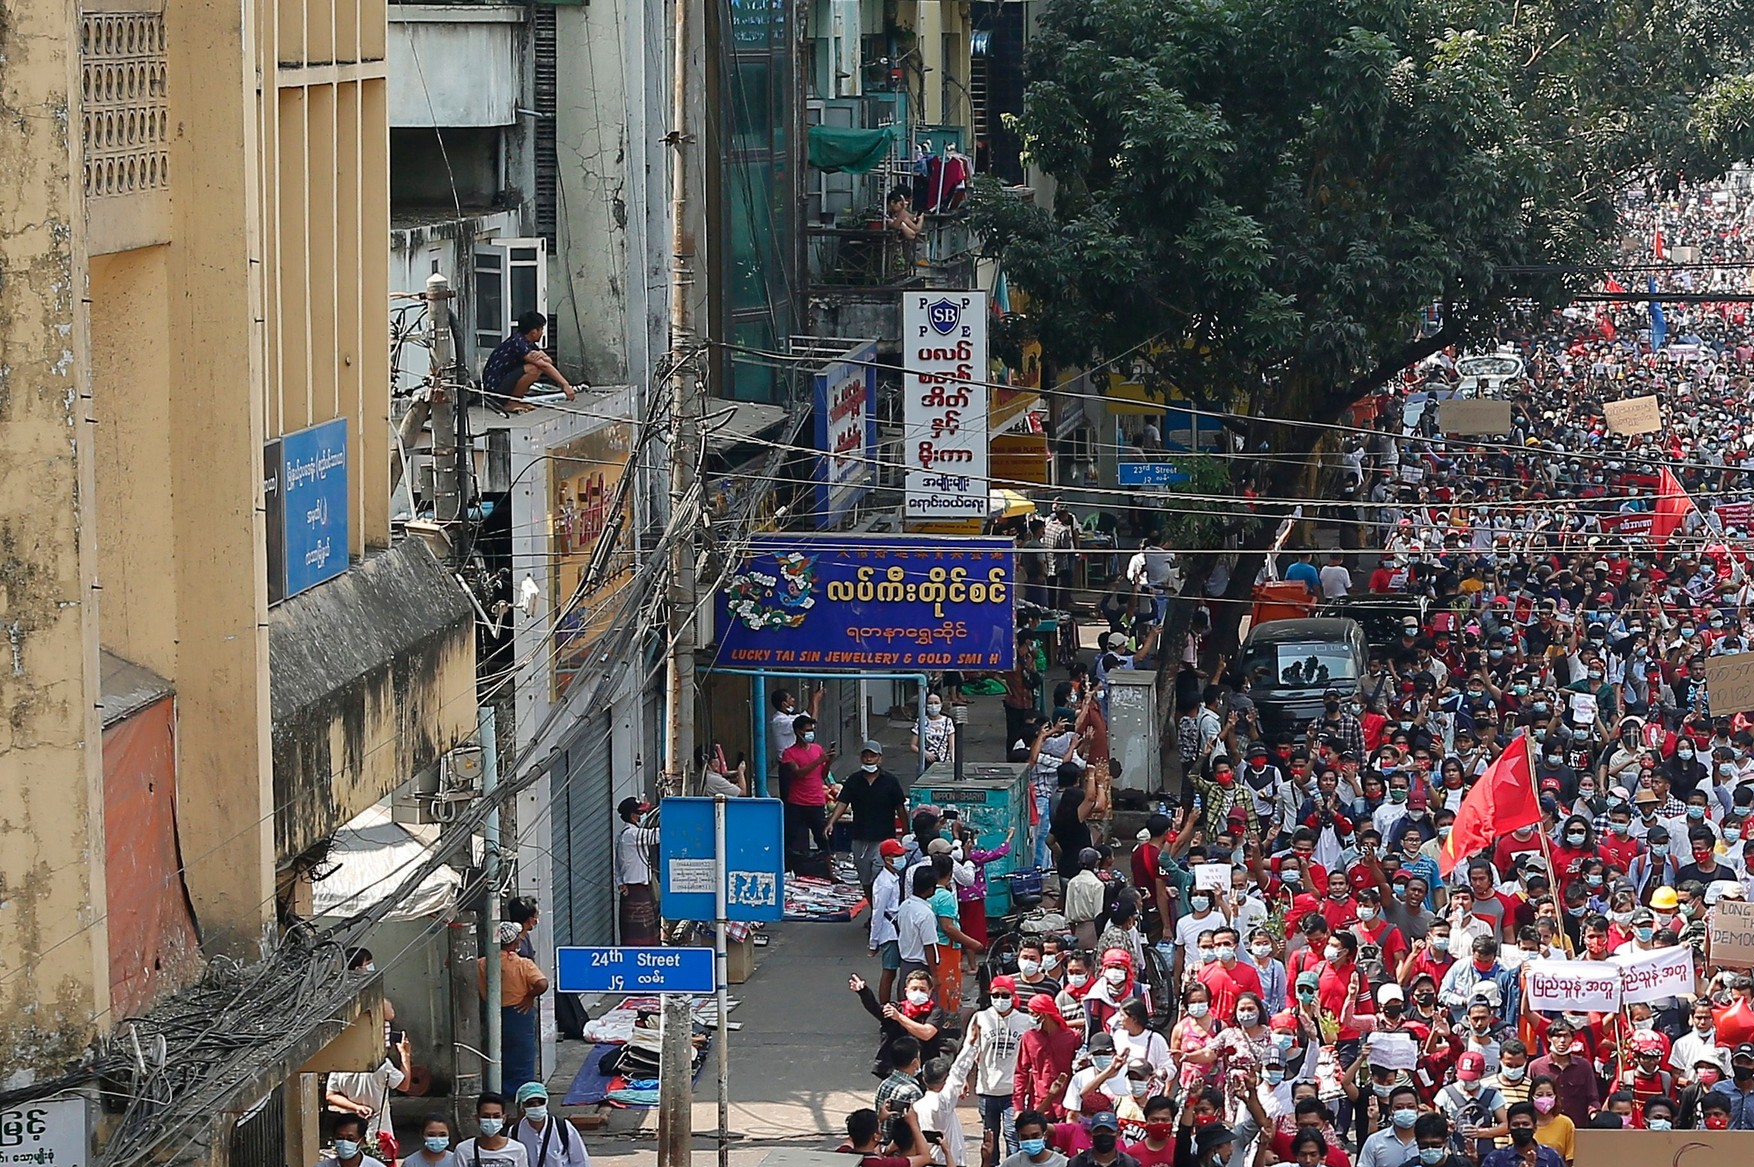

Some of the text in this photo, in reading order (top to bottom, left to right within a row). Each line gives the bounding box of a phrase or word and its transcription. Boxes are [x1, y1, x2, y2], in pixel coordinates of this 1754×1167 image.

[919, 298, 970, 309] P P
[934, 308, 956, 322] SB
[919, 326, 971, 337] P E
[918, 340, 973, 361] ပလပ်
[921, 386, 973, 407] အိတ်
[919, 441, 973, 469] မိုးကာ
[1133, 464, 1177, 474] 23rd Street
[731, 649, 999, 665] LUCKY TAI SIN JEWELLERY & GOLD SMIH
[933, 791, 985, 802] NIPPON SHARYO
[1722, 904, 1751, 916] LONG
[591, 949, 680, 967] 24th Street
[637, 970, 665, 984] လမ်း
[1463, 1058, 1472, 1070] R
